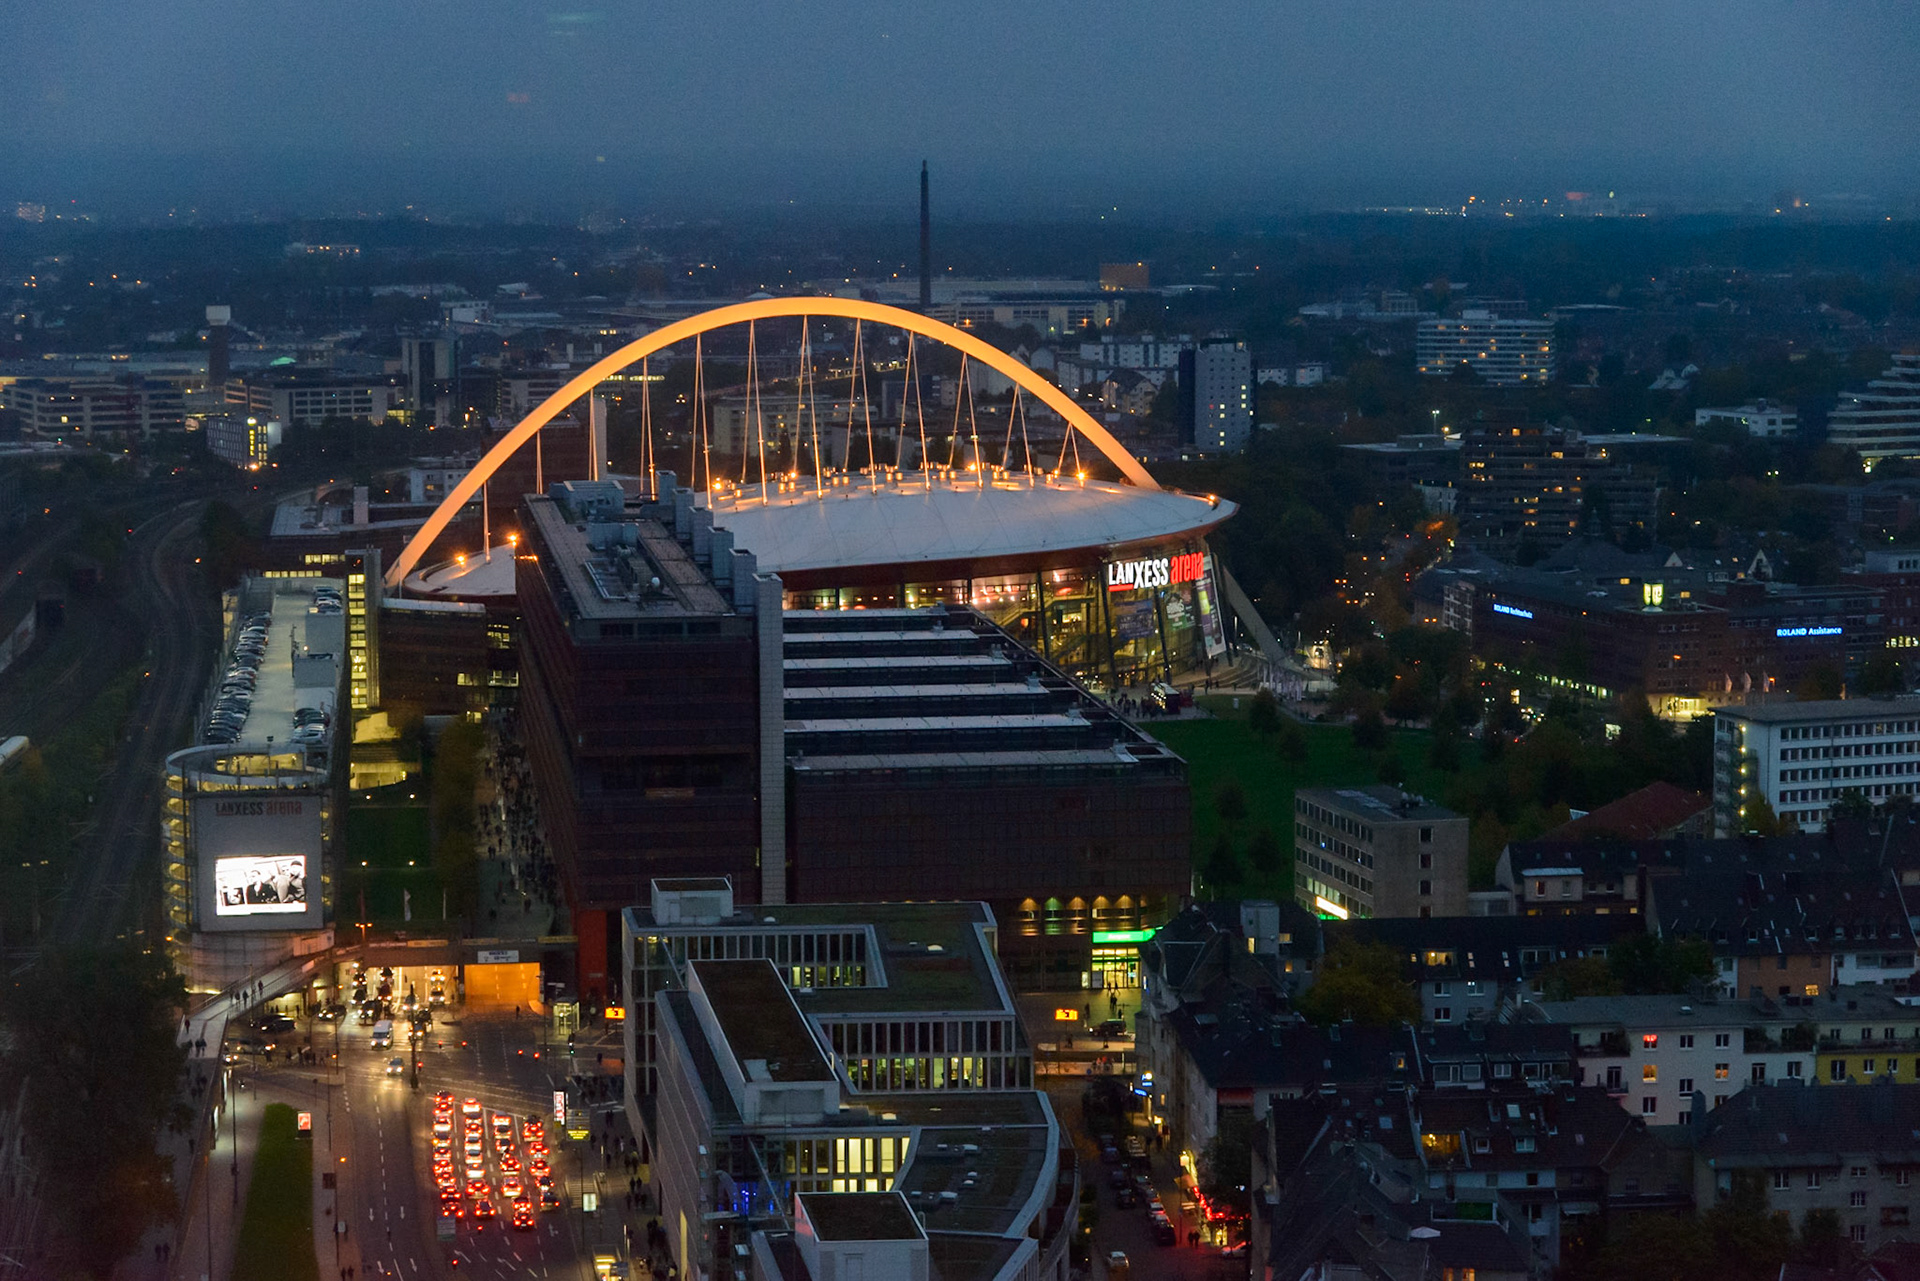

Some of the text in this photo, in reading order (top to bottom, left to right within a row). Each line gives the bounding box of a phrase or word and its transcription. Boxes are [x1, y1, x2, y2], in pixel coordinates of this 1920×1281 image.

[1108, 551, 1204, 590] LANXESS arena
[1776, 626, 1842, 637] ROLAND Assistance
[215, 800, 302, 816] LANXESS arena
